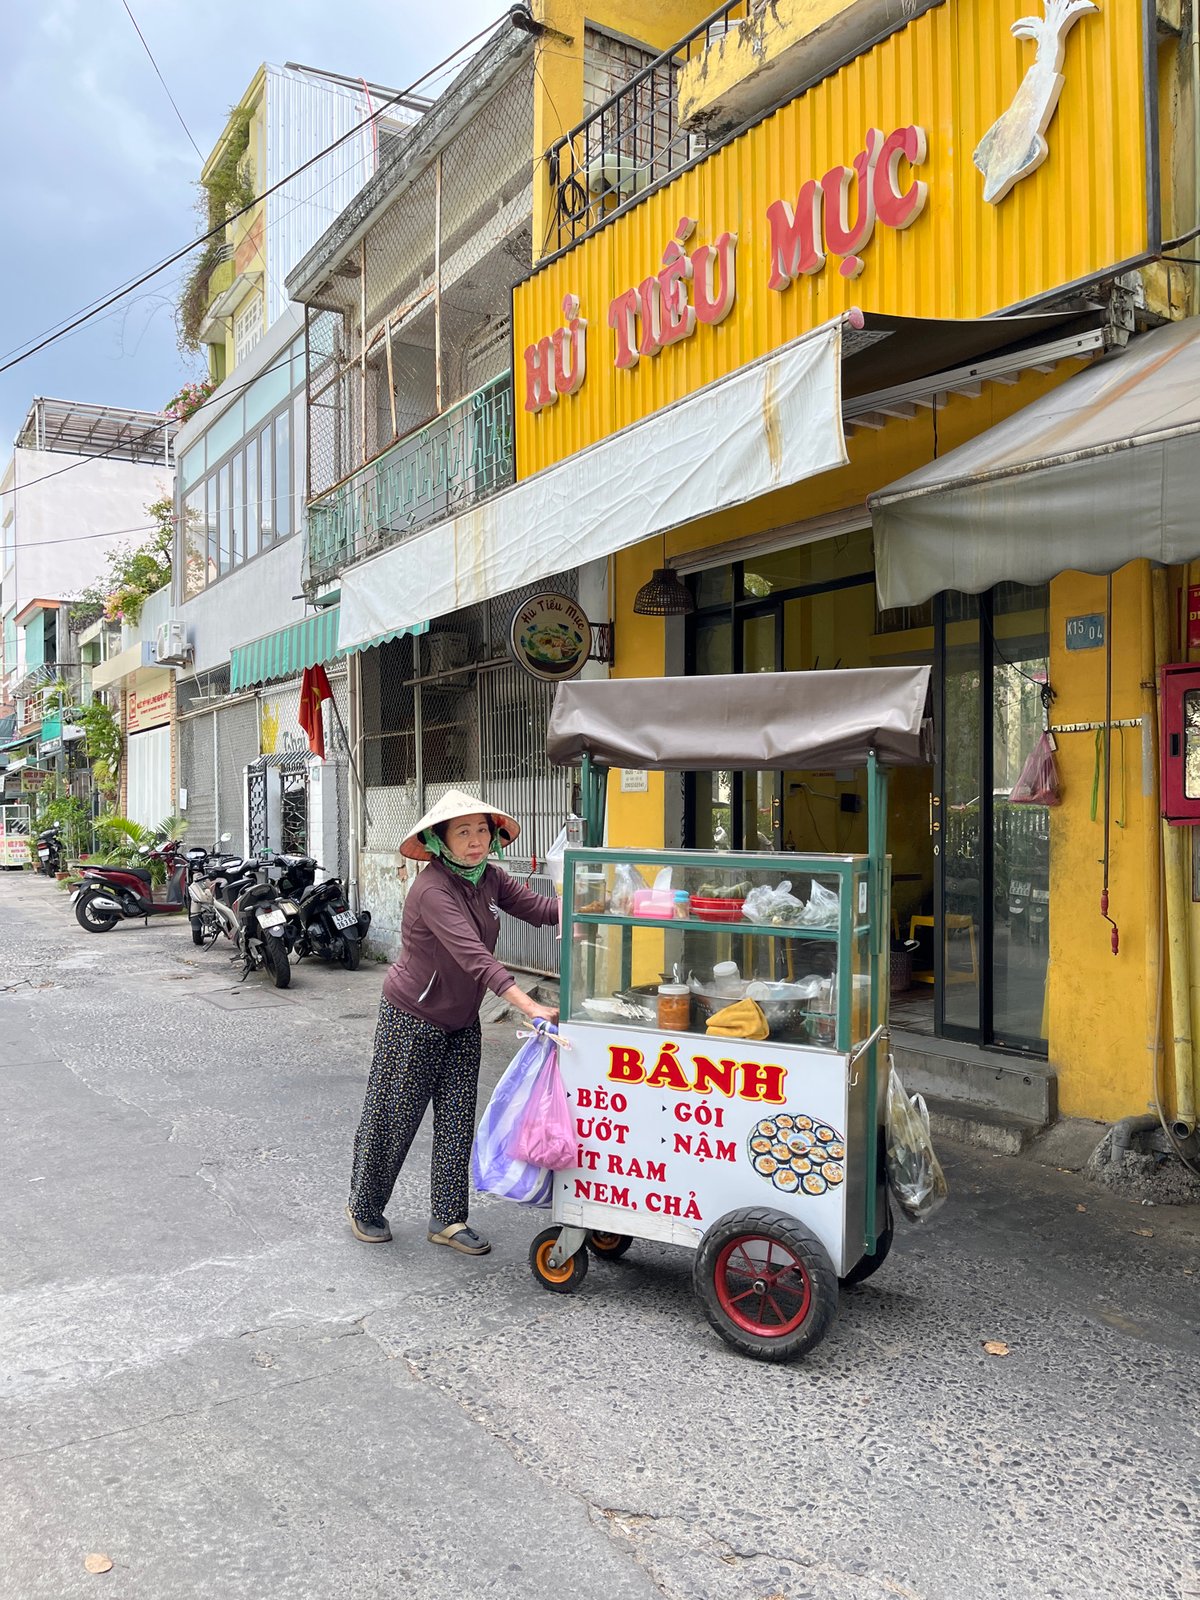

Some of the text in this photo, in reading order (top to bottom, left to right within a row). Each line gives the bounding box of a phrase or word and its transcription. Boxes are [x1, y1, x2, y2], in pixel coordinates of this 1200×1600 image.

[523, 125, 928, 413] HỦ TIẾU MỰC
[608, 1042, 788, 1105] BÁNH
[577, 1085, 628, 1113] BÈO
[674, 1100, 724, 1128] GÓI
[576, 1116, 630, 1144] ƯỚT
[673, 1131, 737, 1163] NẬM
[607, 1154, 667, 1183] RAM
[574, 1179, 703, 1221] NEM, CHẢ
